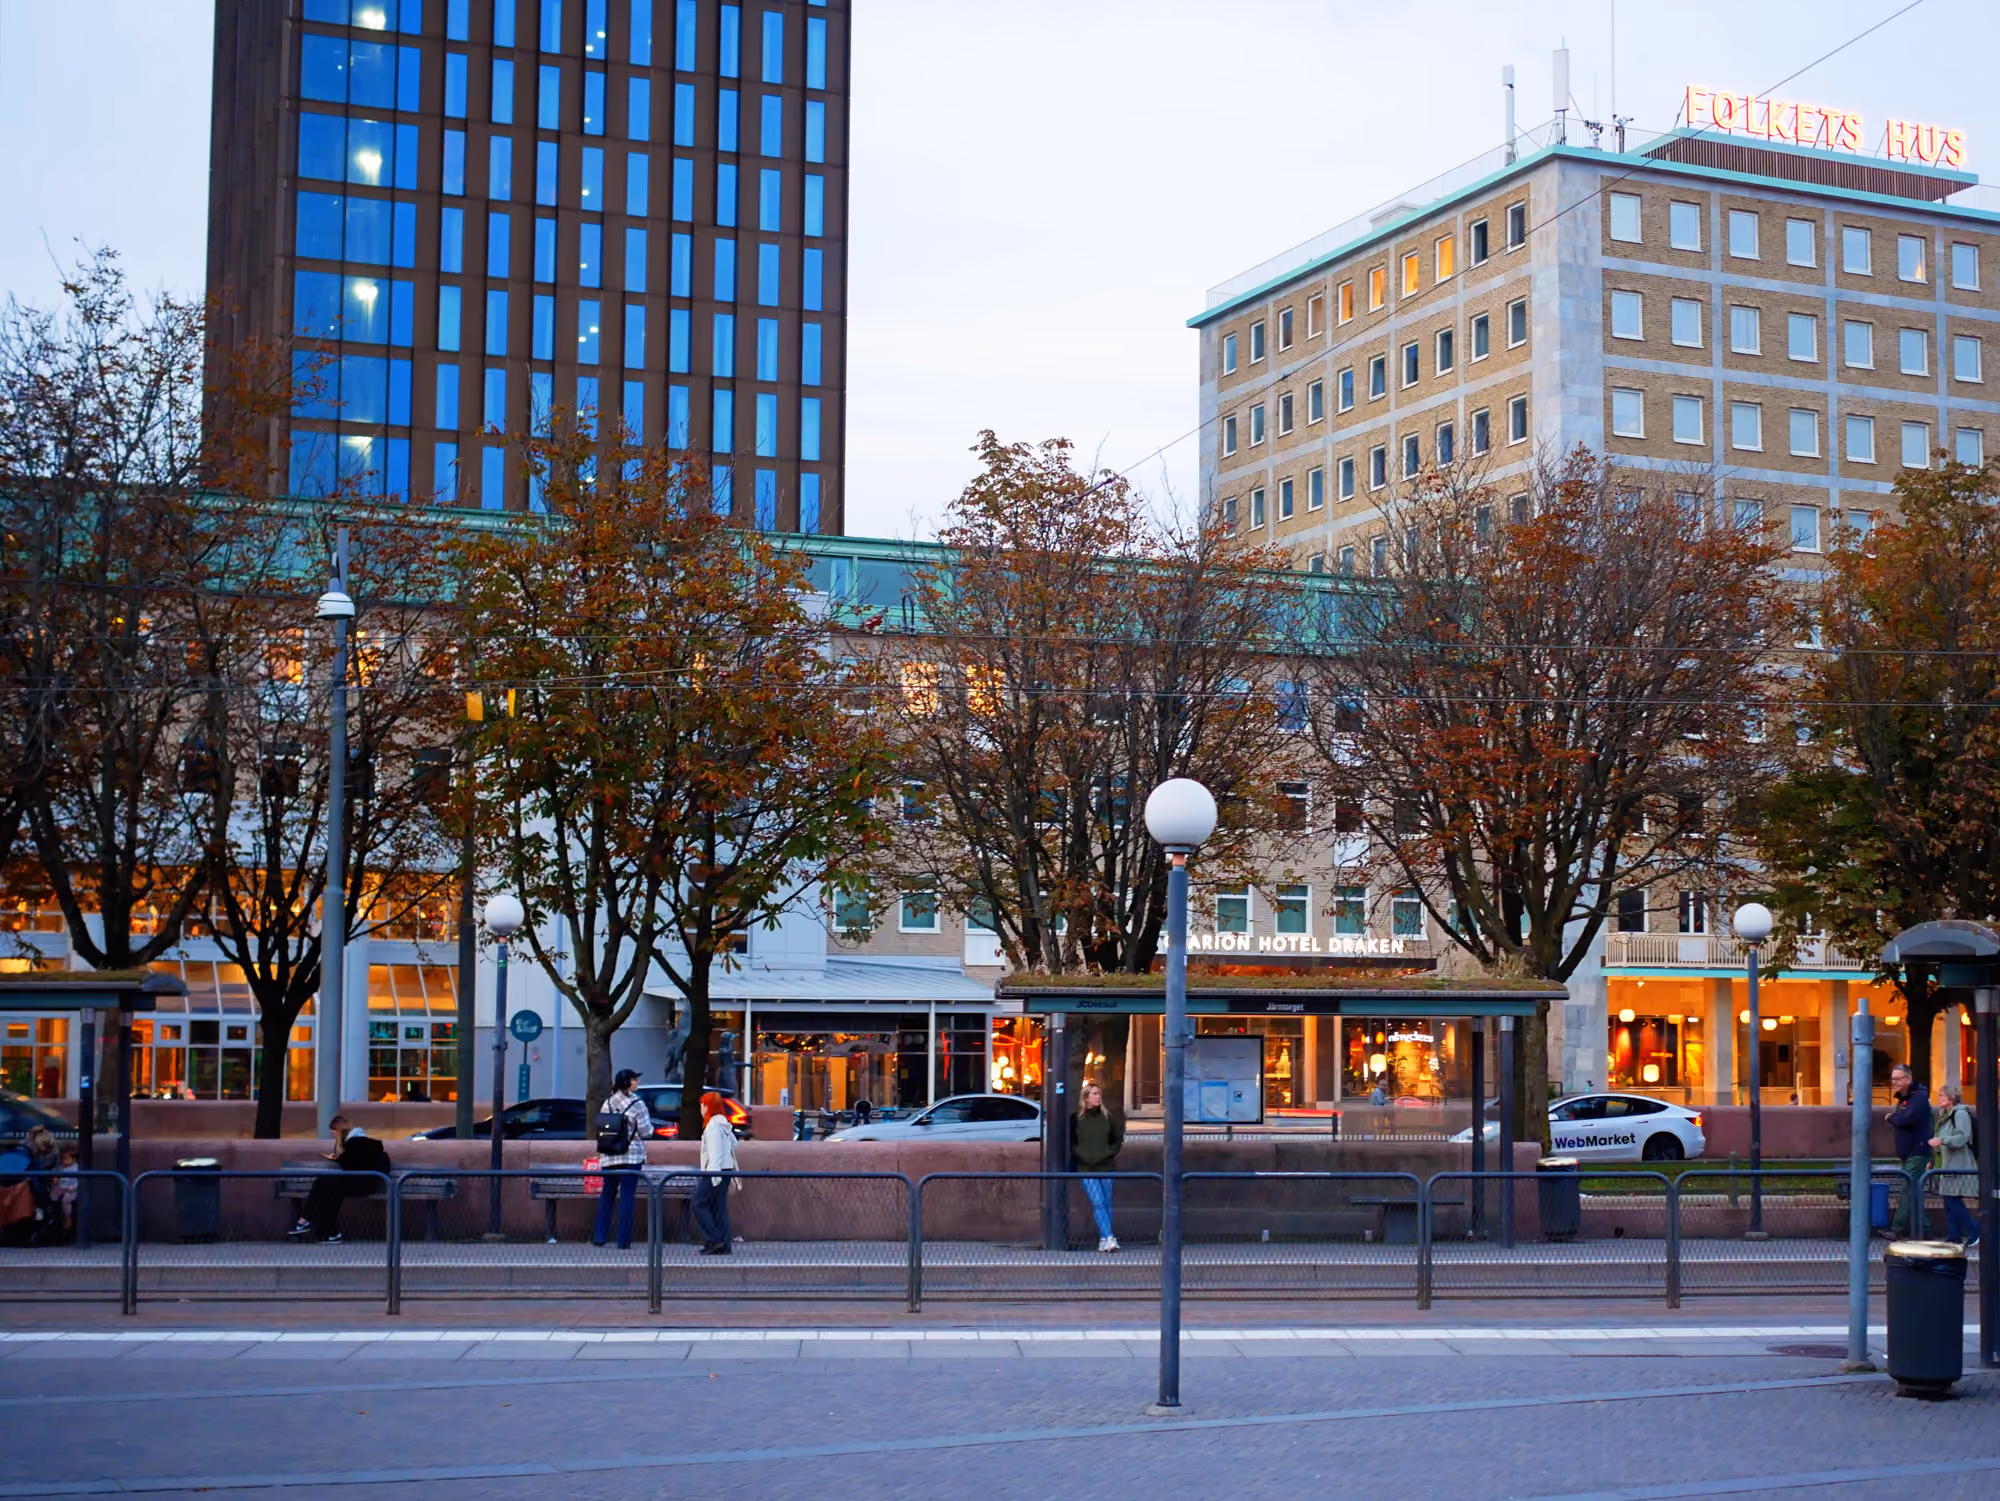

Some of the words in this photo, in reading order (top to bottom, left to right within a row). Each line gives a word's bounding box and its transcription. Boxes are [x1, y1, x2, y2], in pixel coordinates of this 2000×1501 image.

[1686, 84, 1865, 151] FOLKETS
[1886, 117, 1967, 167] HUS
[1259, 935, 1321, 952] HOTEL
[1328, 937, 1404, 954] DRAKEN
[1554, 1132, 1637, 1149] WebMarket
